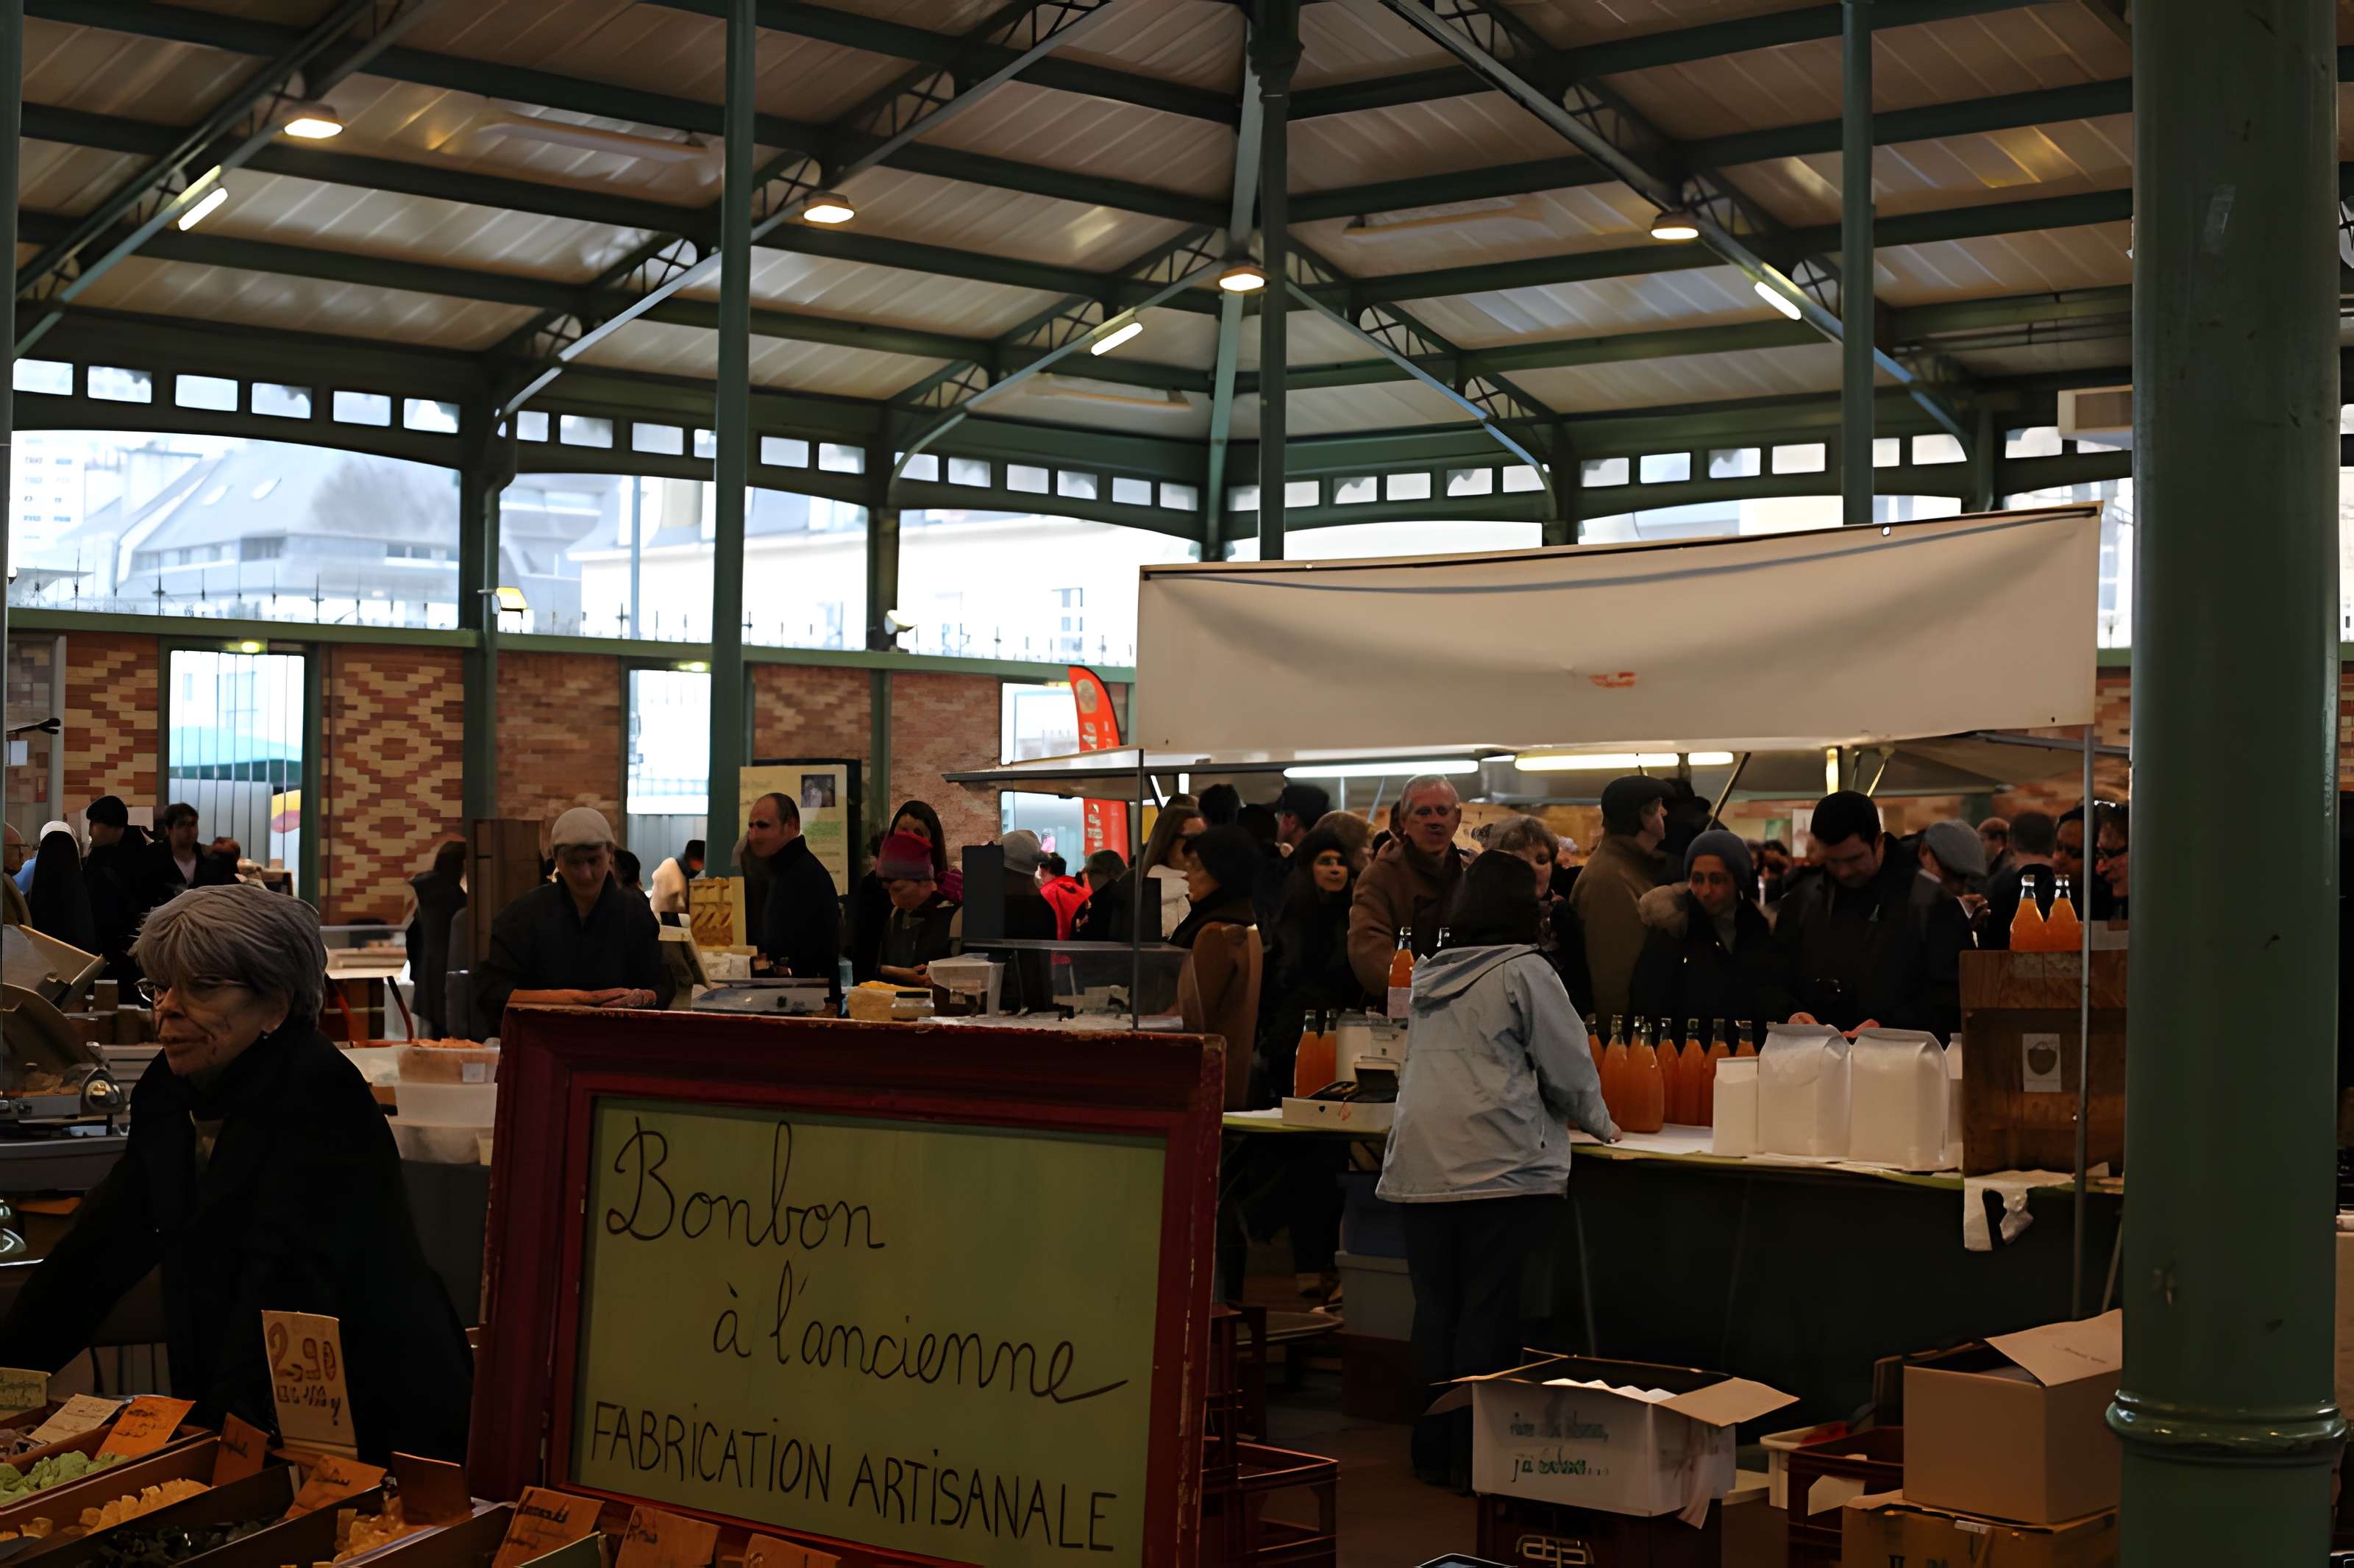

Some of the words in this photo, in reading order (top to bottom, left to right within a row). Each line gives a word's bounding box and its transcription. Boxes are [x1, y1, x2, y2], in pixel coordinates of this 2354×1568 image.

[605, 1116, 885, 1250] Bonbon
[713, 1281, 751, 1358] à
[769, 1259, 1129, 1404] l'ancienne
